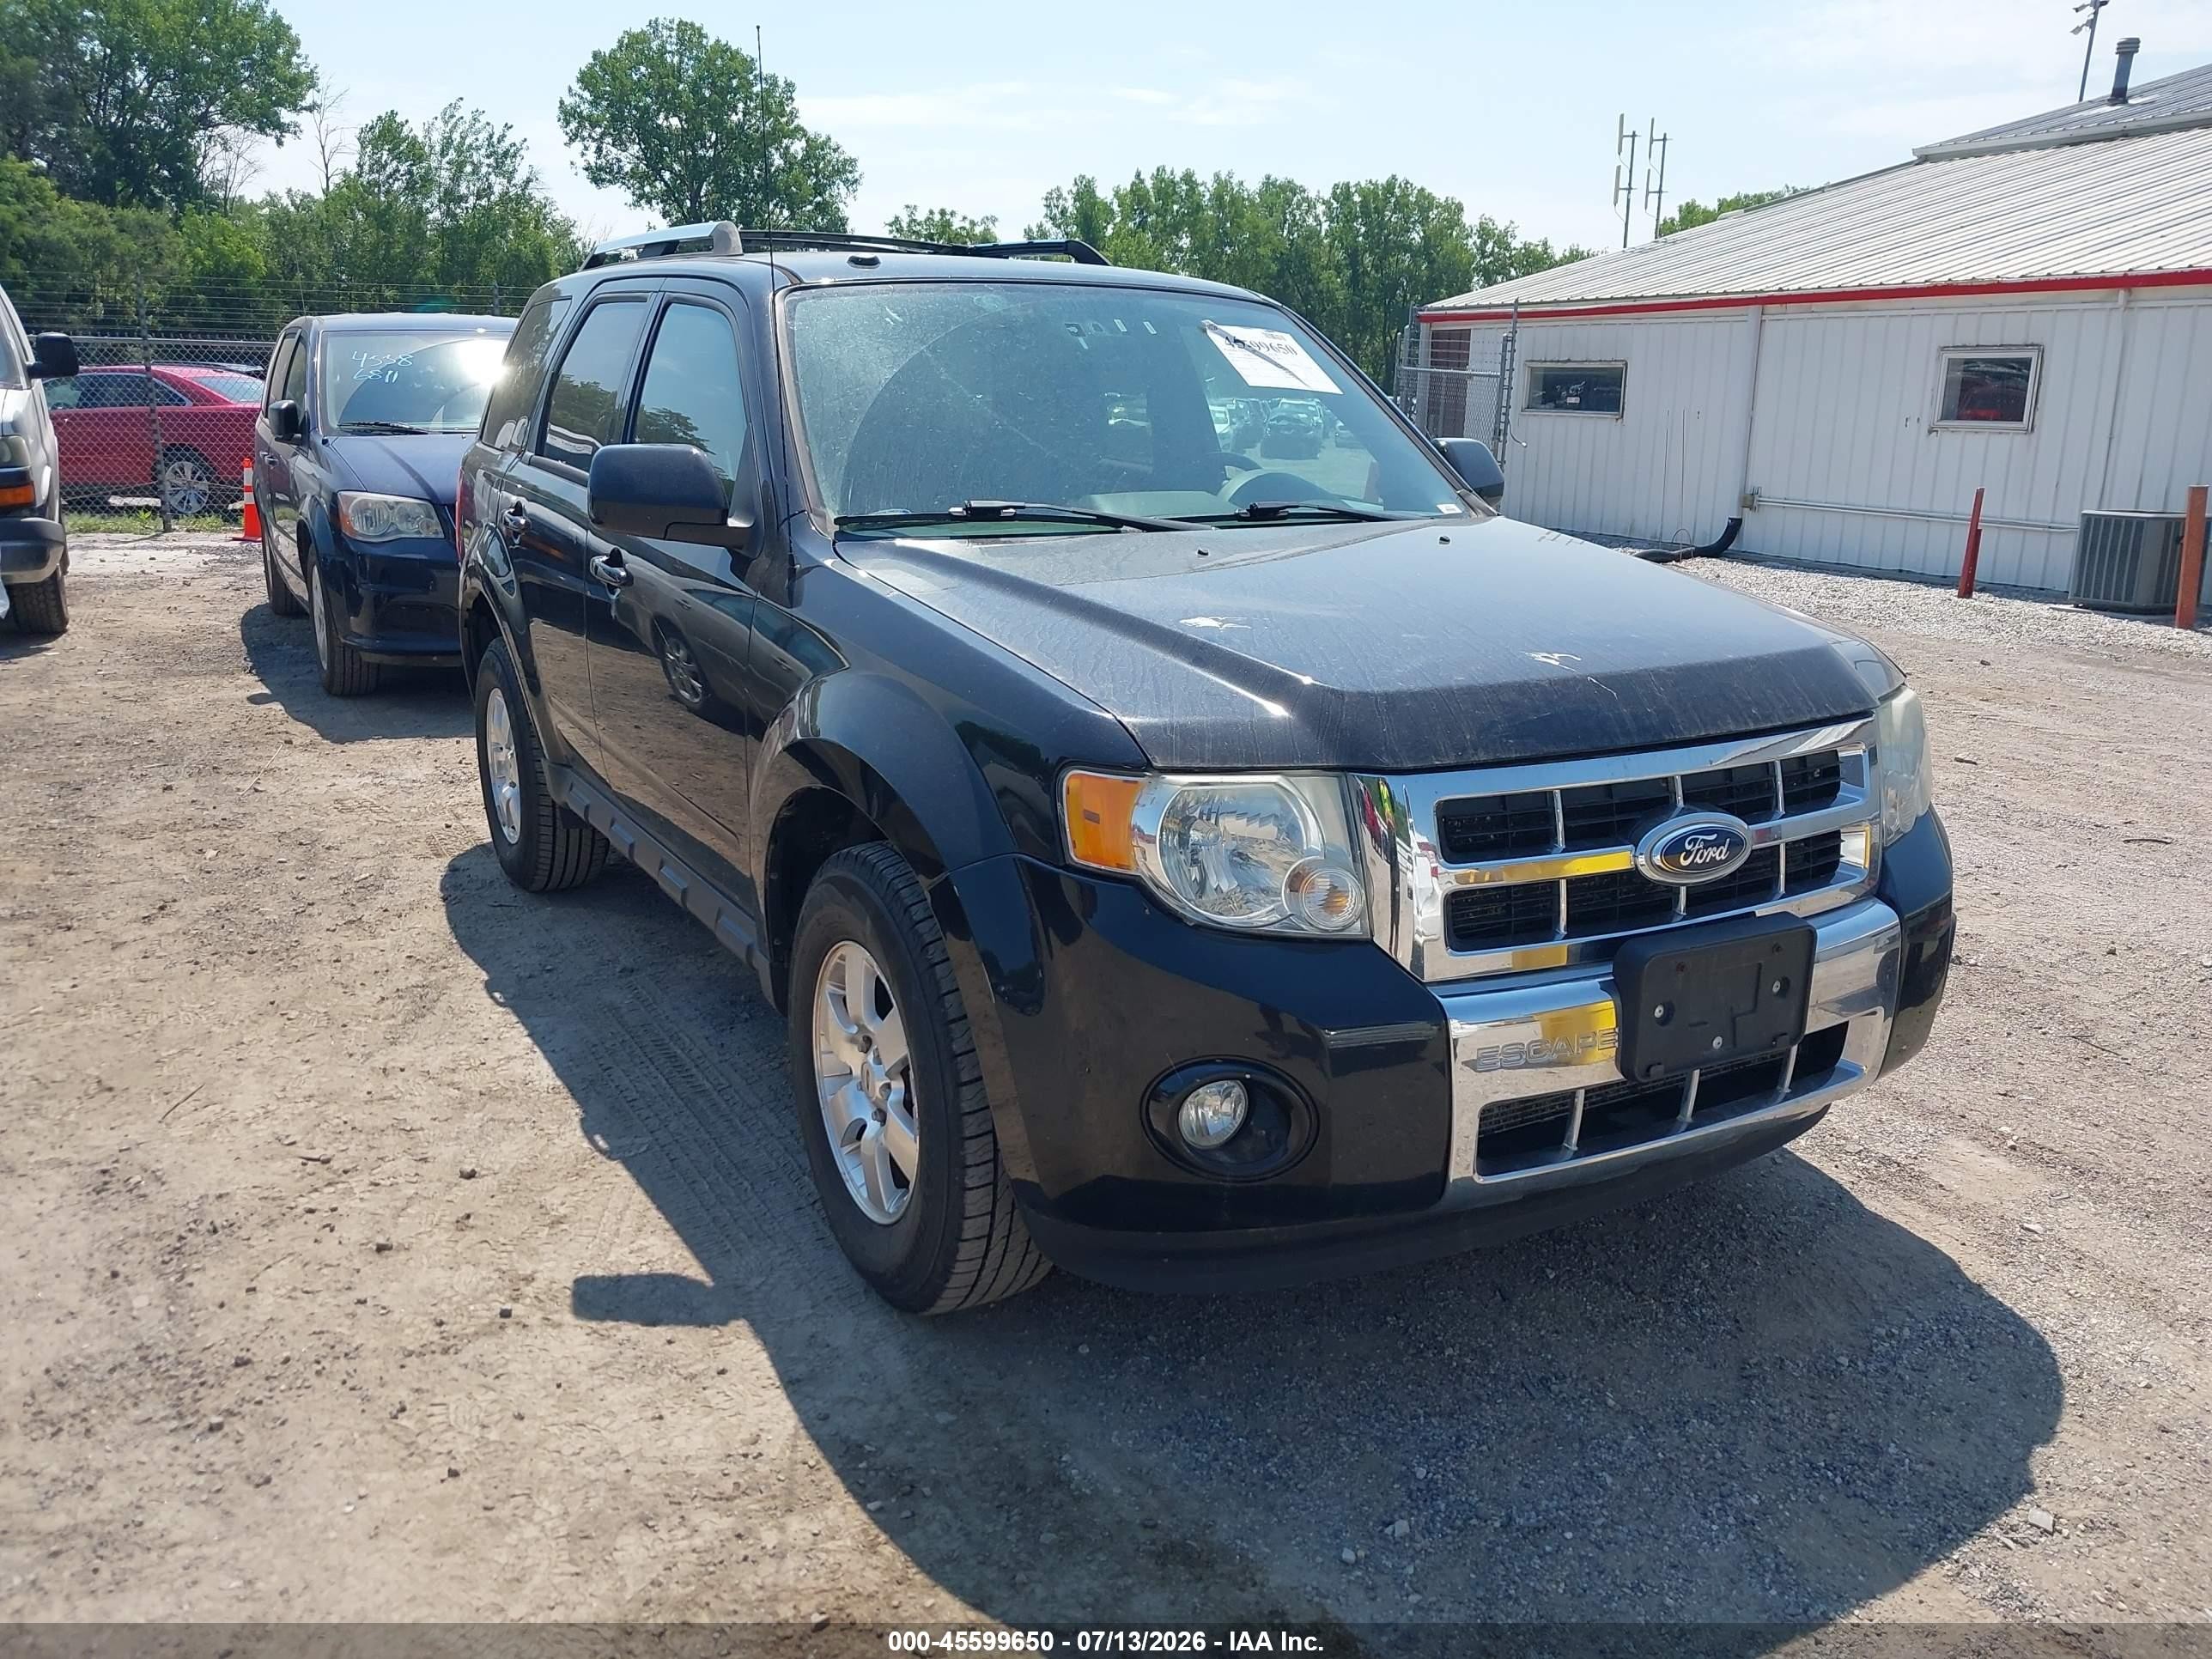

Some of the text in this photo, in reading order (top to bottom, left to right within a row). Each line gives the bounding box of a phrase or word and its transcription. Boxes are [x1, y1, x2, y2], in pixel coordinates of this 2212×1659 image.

[353, 368, 398, 383] 6811
[1680, 833, 1730, 866] Ford
[1476, 1027, 1619, 1072] ESCAPE
